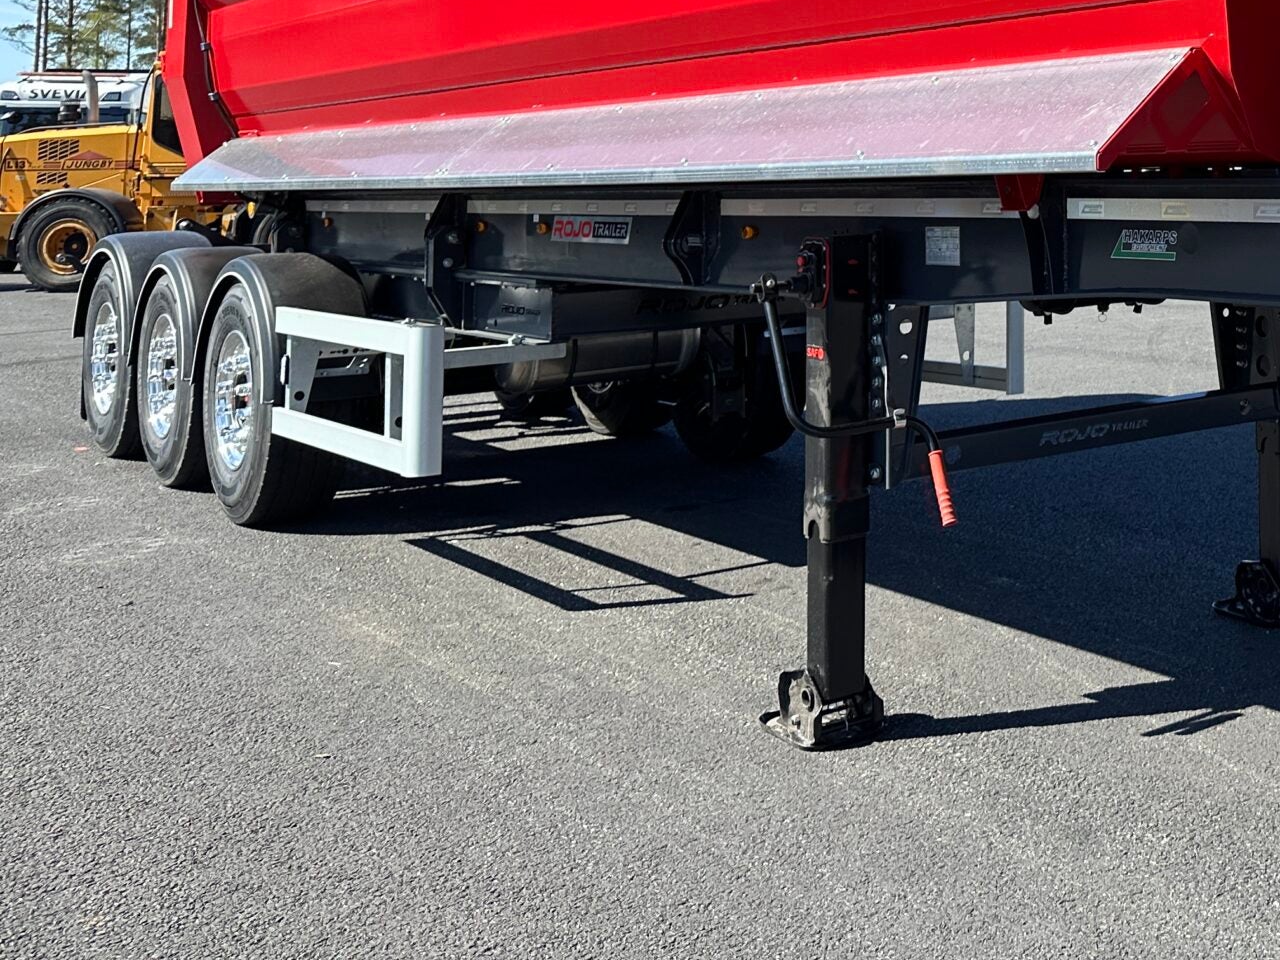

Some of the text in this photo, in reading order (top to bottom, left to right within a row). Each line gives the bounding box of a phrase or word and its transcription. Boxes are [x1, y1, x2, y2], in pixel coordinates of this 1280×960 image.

[552, 218, 628, 239] ROJO TRAILER
[1122, 229, 1178, 245] HAKARPS
[1039, 423, 1110, 447] ROJO
